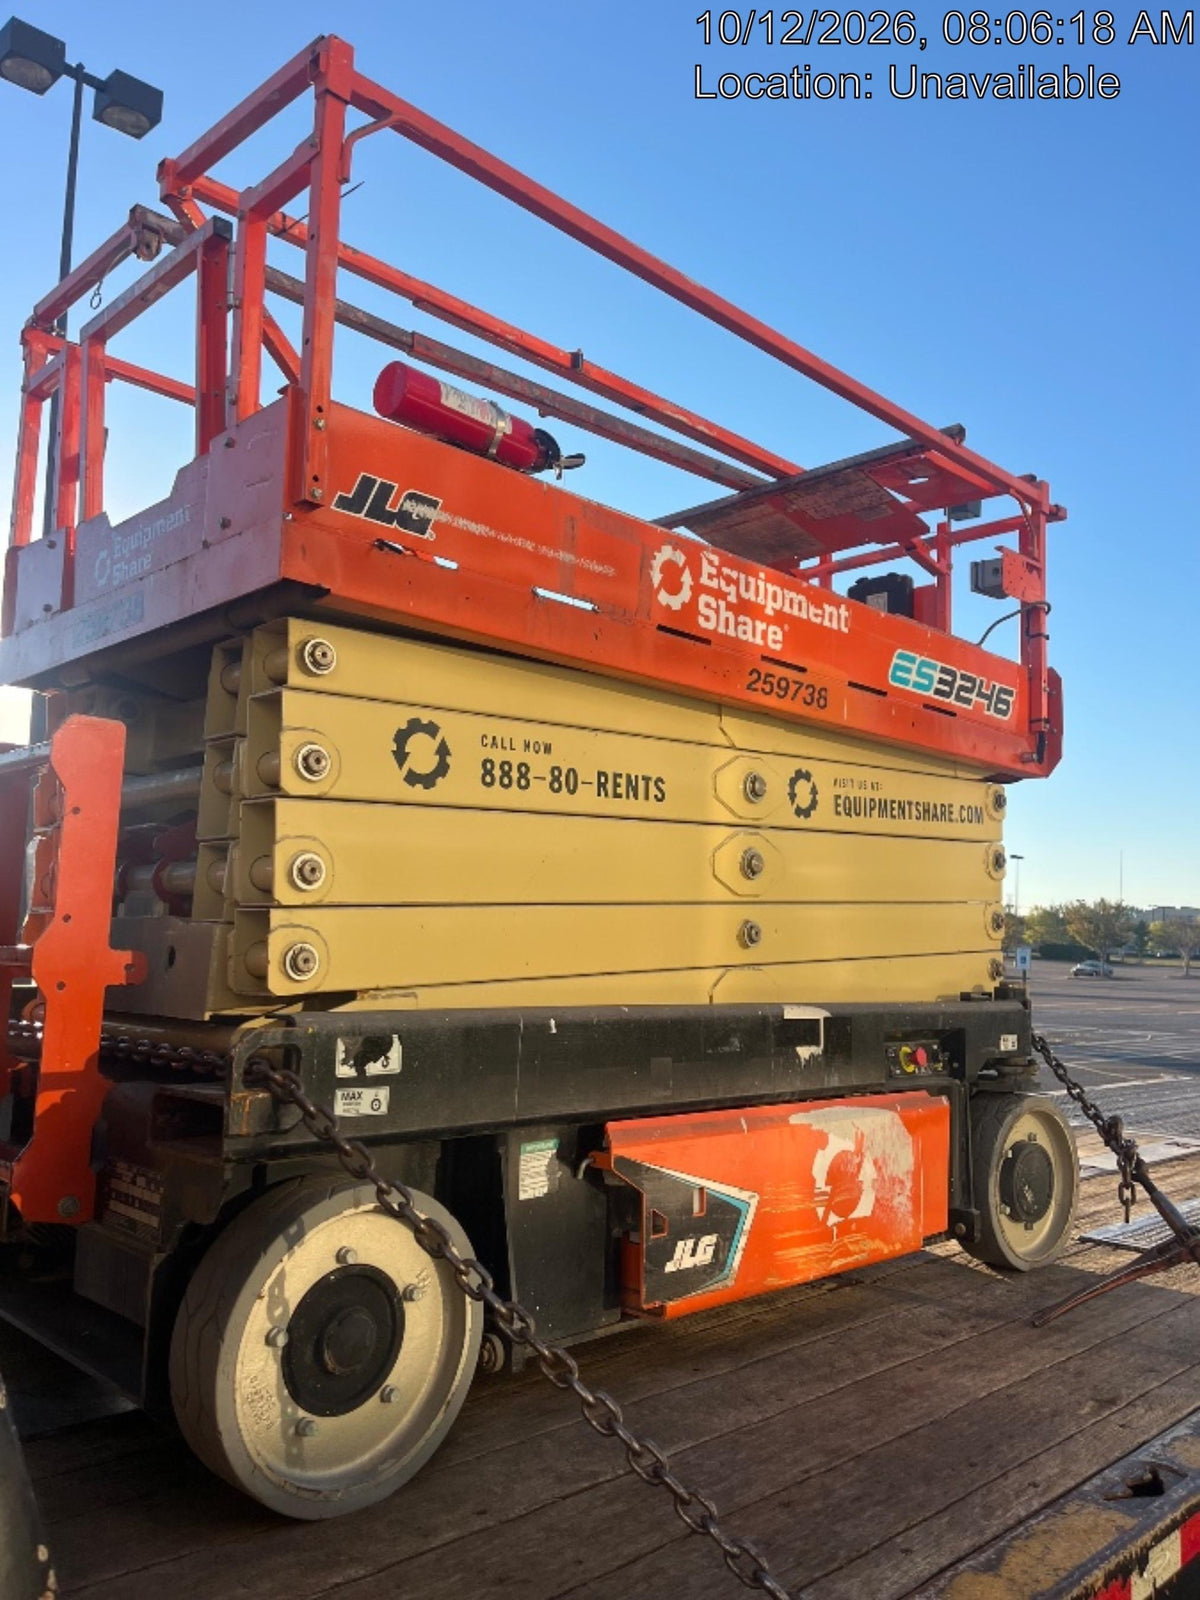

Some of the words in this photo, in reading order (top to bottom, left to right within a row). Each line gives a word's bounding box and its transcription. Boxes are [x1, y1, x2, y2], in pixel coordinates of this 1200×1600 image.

[331, 472, 443, 539] JLG
[111, 505, 191, 559] Equipment
[112, 553, 152, 586] Share
[700, 550, 849, 633] Equipment
[698, 594, 784, 651] Share
[746, 668, 828, 710] 259738
[889, 649, 1016, 720] ES3246
[481, 734, 516, 751] CALL
[524, 739, 552, 755] NOW
[481, 758, 666, 802] 888-80-RENTS
[834, 794, 984, 825] EQUIPMENTSHARE.COM
[341, 1091, 363, 1101] MAX
[664, 1233, 719, 1273] JLG
